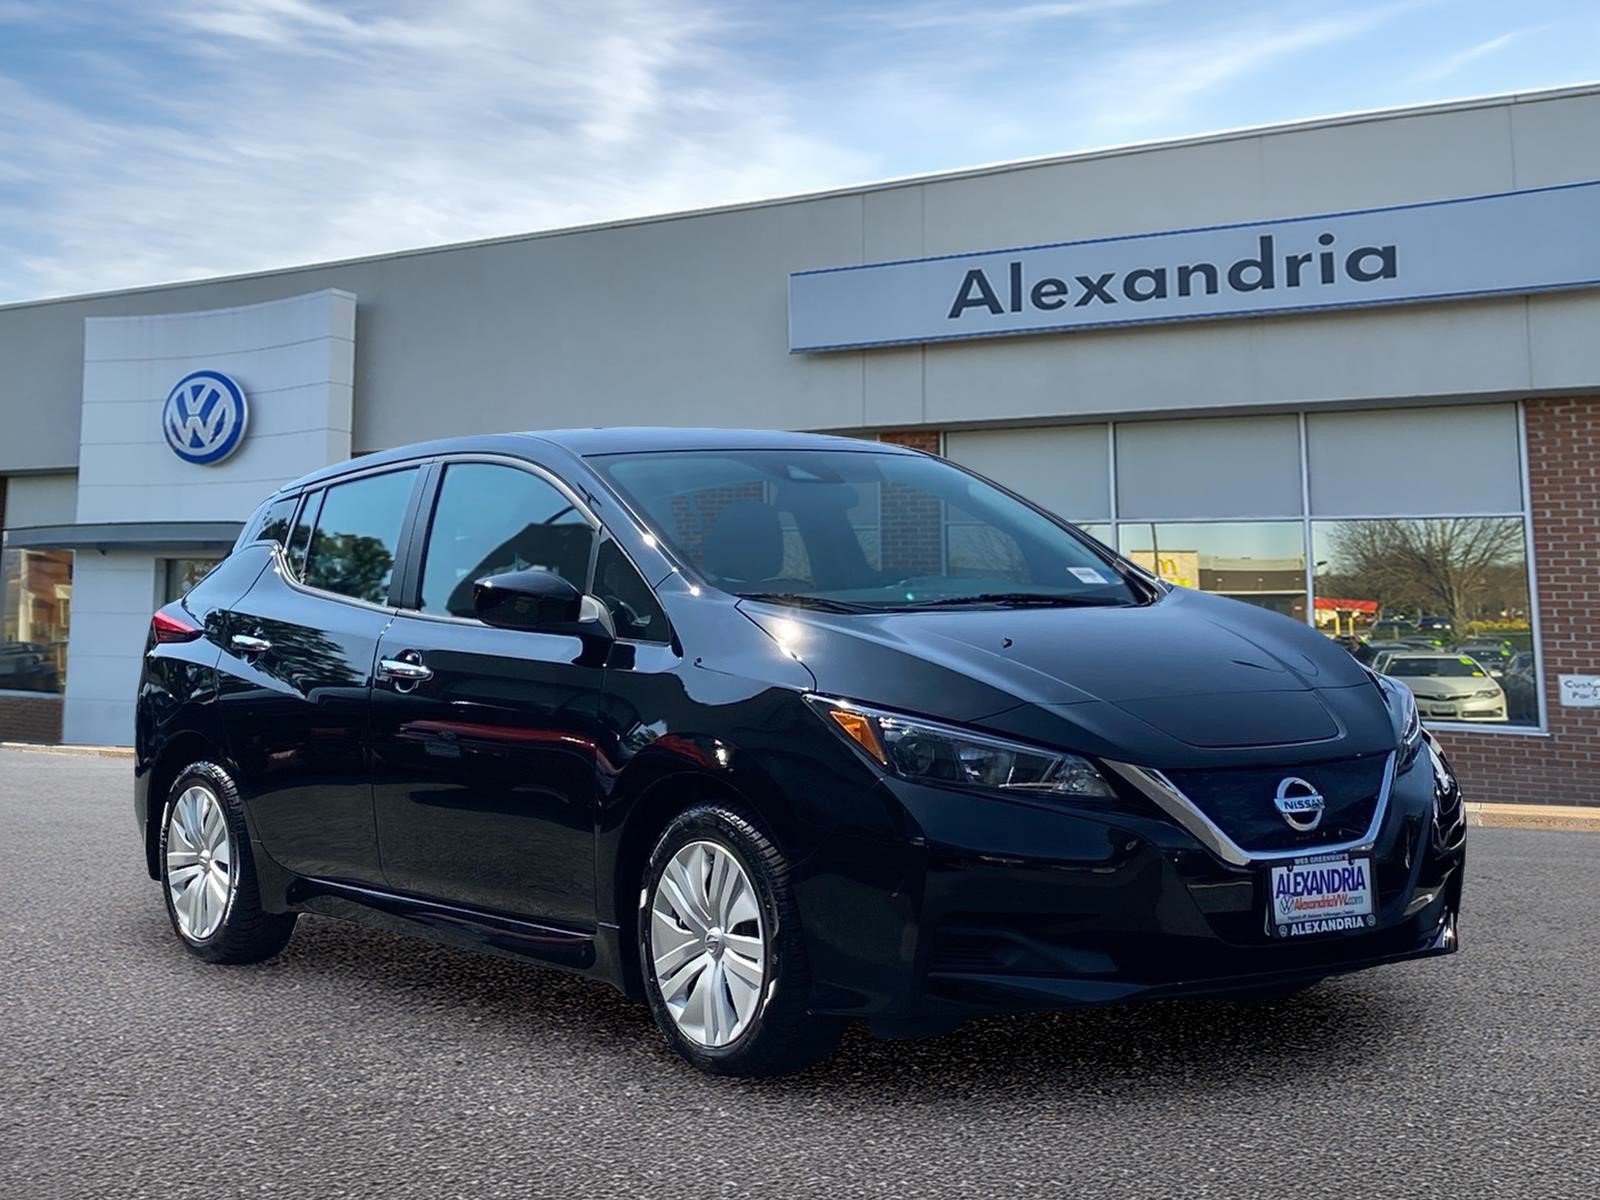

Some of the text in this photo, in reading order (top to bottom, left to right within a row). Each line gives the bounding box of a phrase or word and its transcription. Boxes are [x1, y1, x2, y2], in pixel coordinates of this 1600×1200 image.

[947, 233, 1397, 319] Alexandria
[1284, 798, 1321, 810] NISSAN
[1275, 866, 1367, 899] ALEXANDRIA
[1290, 916, 1365, 936] ALEXANDRIA
